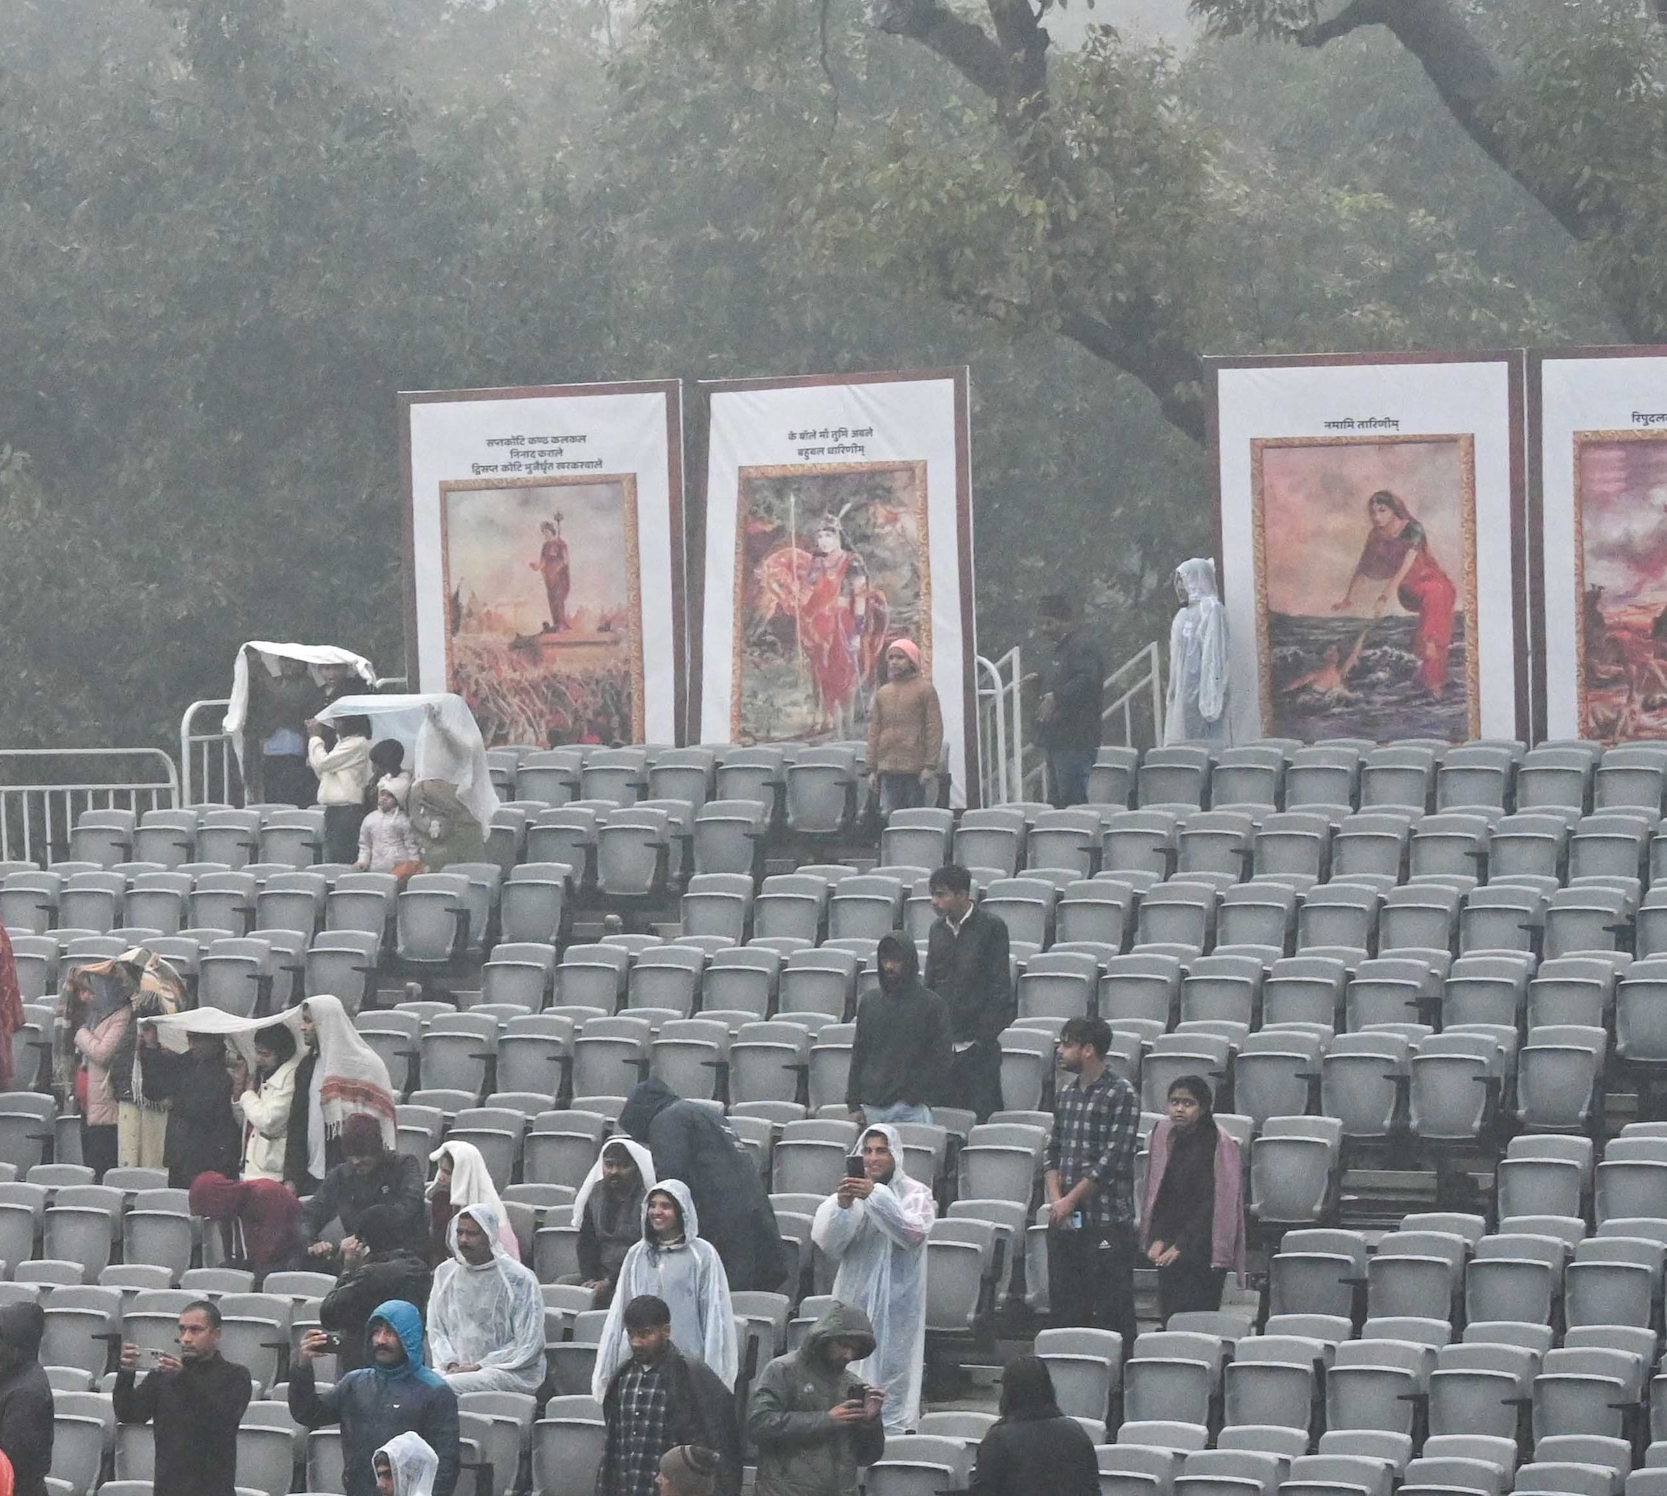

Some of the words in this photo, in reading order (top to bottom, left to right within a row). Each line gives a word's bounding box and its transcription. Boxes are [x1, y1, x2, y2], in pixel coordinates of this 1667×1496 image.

[1324, 417, 1355, 430] नमामि
[1357, 416, 1400, 431] तारिणीम्
[1631, 410, 1667, 427] रिपुदल
